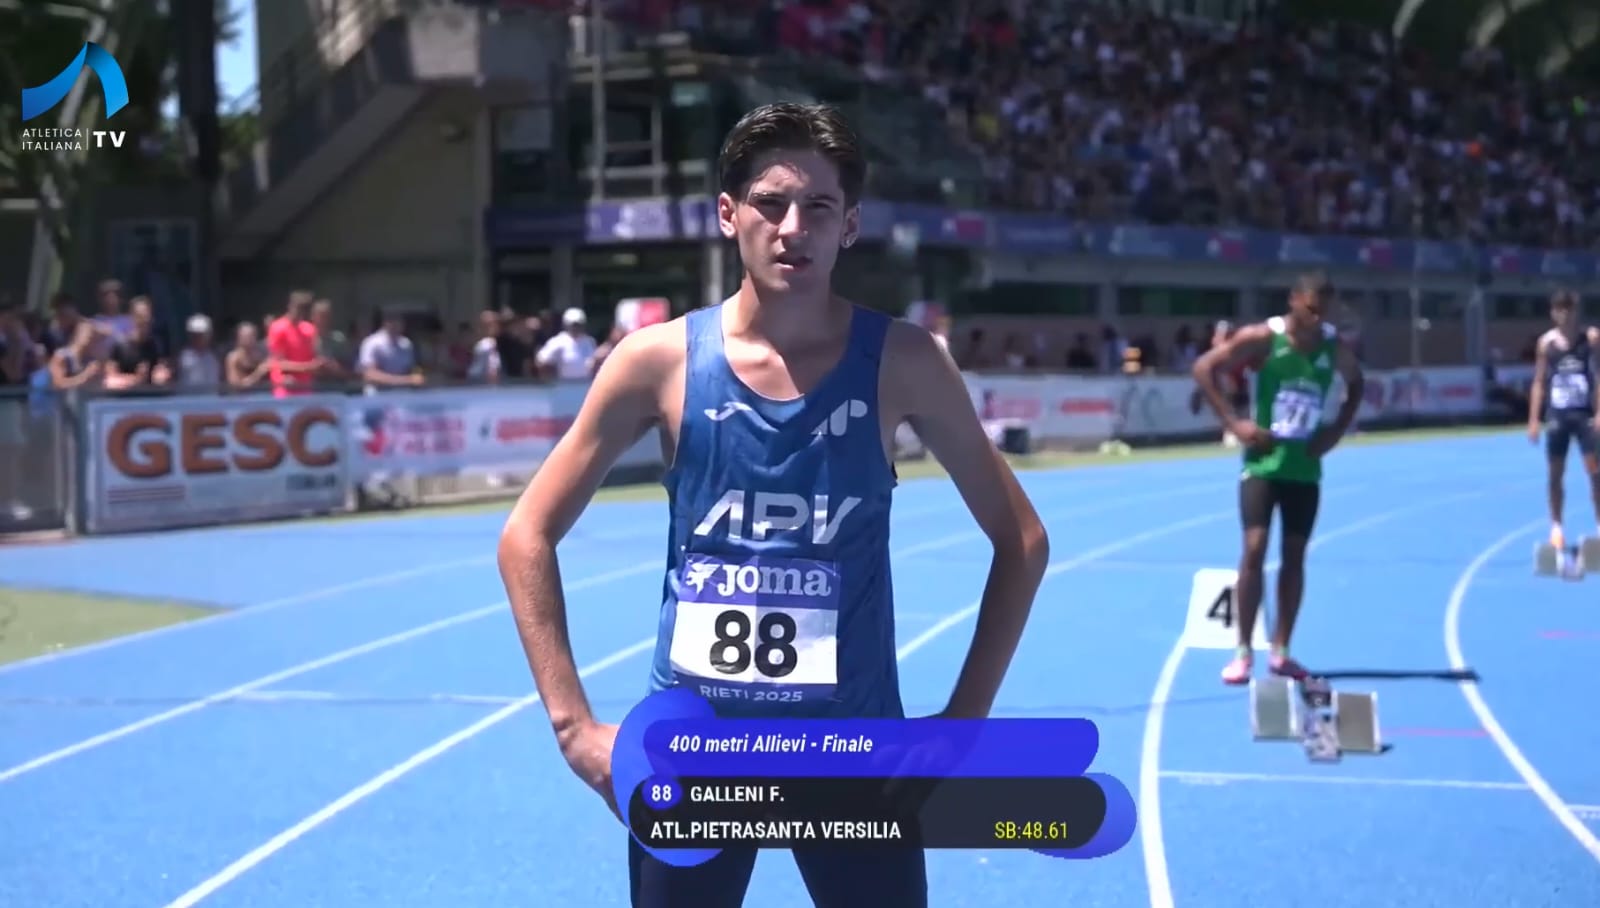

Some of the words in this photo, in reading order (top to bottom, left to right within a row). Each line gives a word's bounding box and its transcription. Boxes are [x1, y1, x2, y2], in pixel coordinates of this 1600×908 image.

[107, 406, 338, 479] GESC
[1207, 586, 1233, 628] 4
[709, 610, 798, 678] 88
[699, 685, 749, 699] RIETI
[753, 691, 803, 702] 2025
